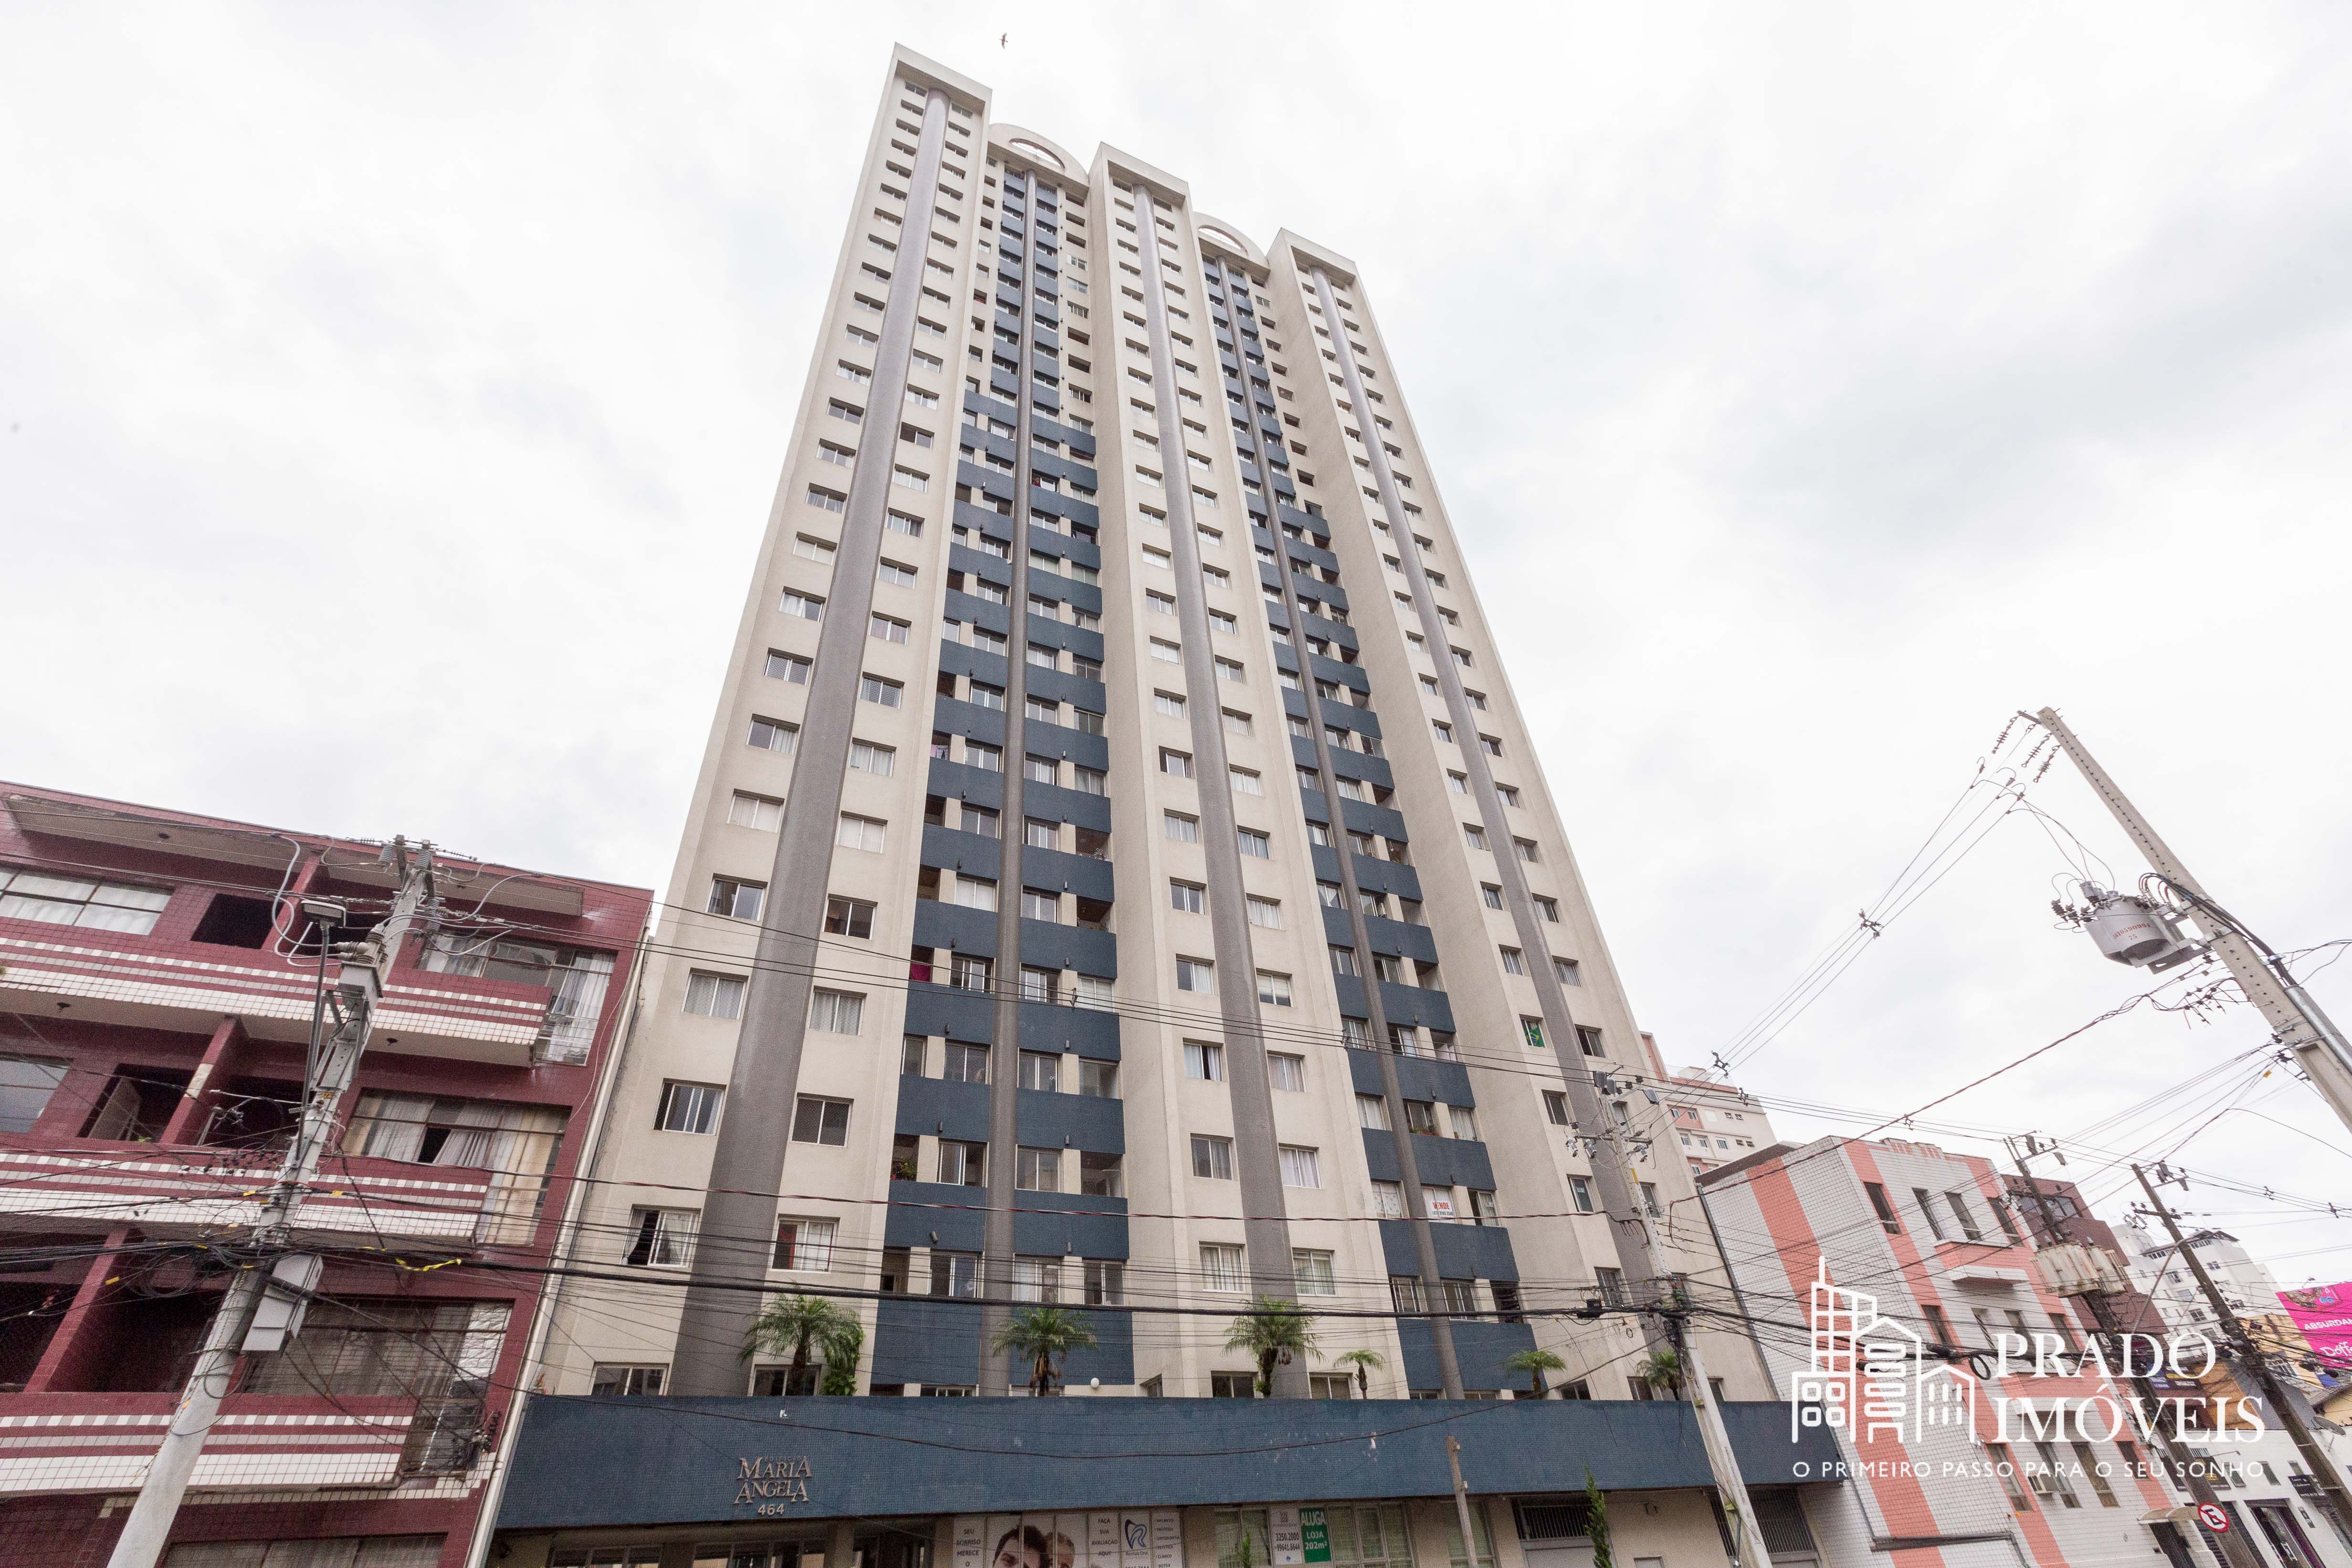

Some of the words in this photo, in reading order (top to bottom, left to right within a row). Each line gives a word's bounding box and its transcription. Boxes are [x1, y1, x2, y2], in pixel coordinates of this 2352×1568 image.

[737, 1456, 812, 1479] MARIA
[758, 1504, 784, 1515] 464
[2205, 1508, 2222, 1526] E
[1301, 1511, 1326, 1526] ALUGA
[1306, 1530, 1324, 1539] LOJA
